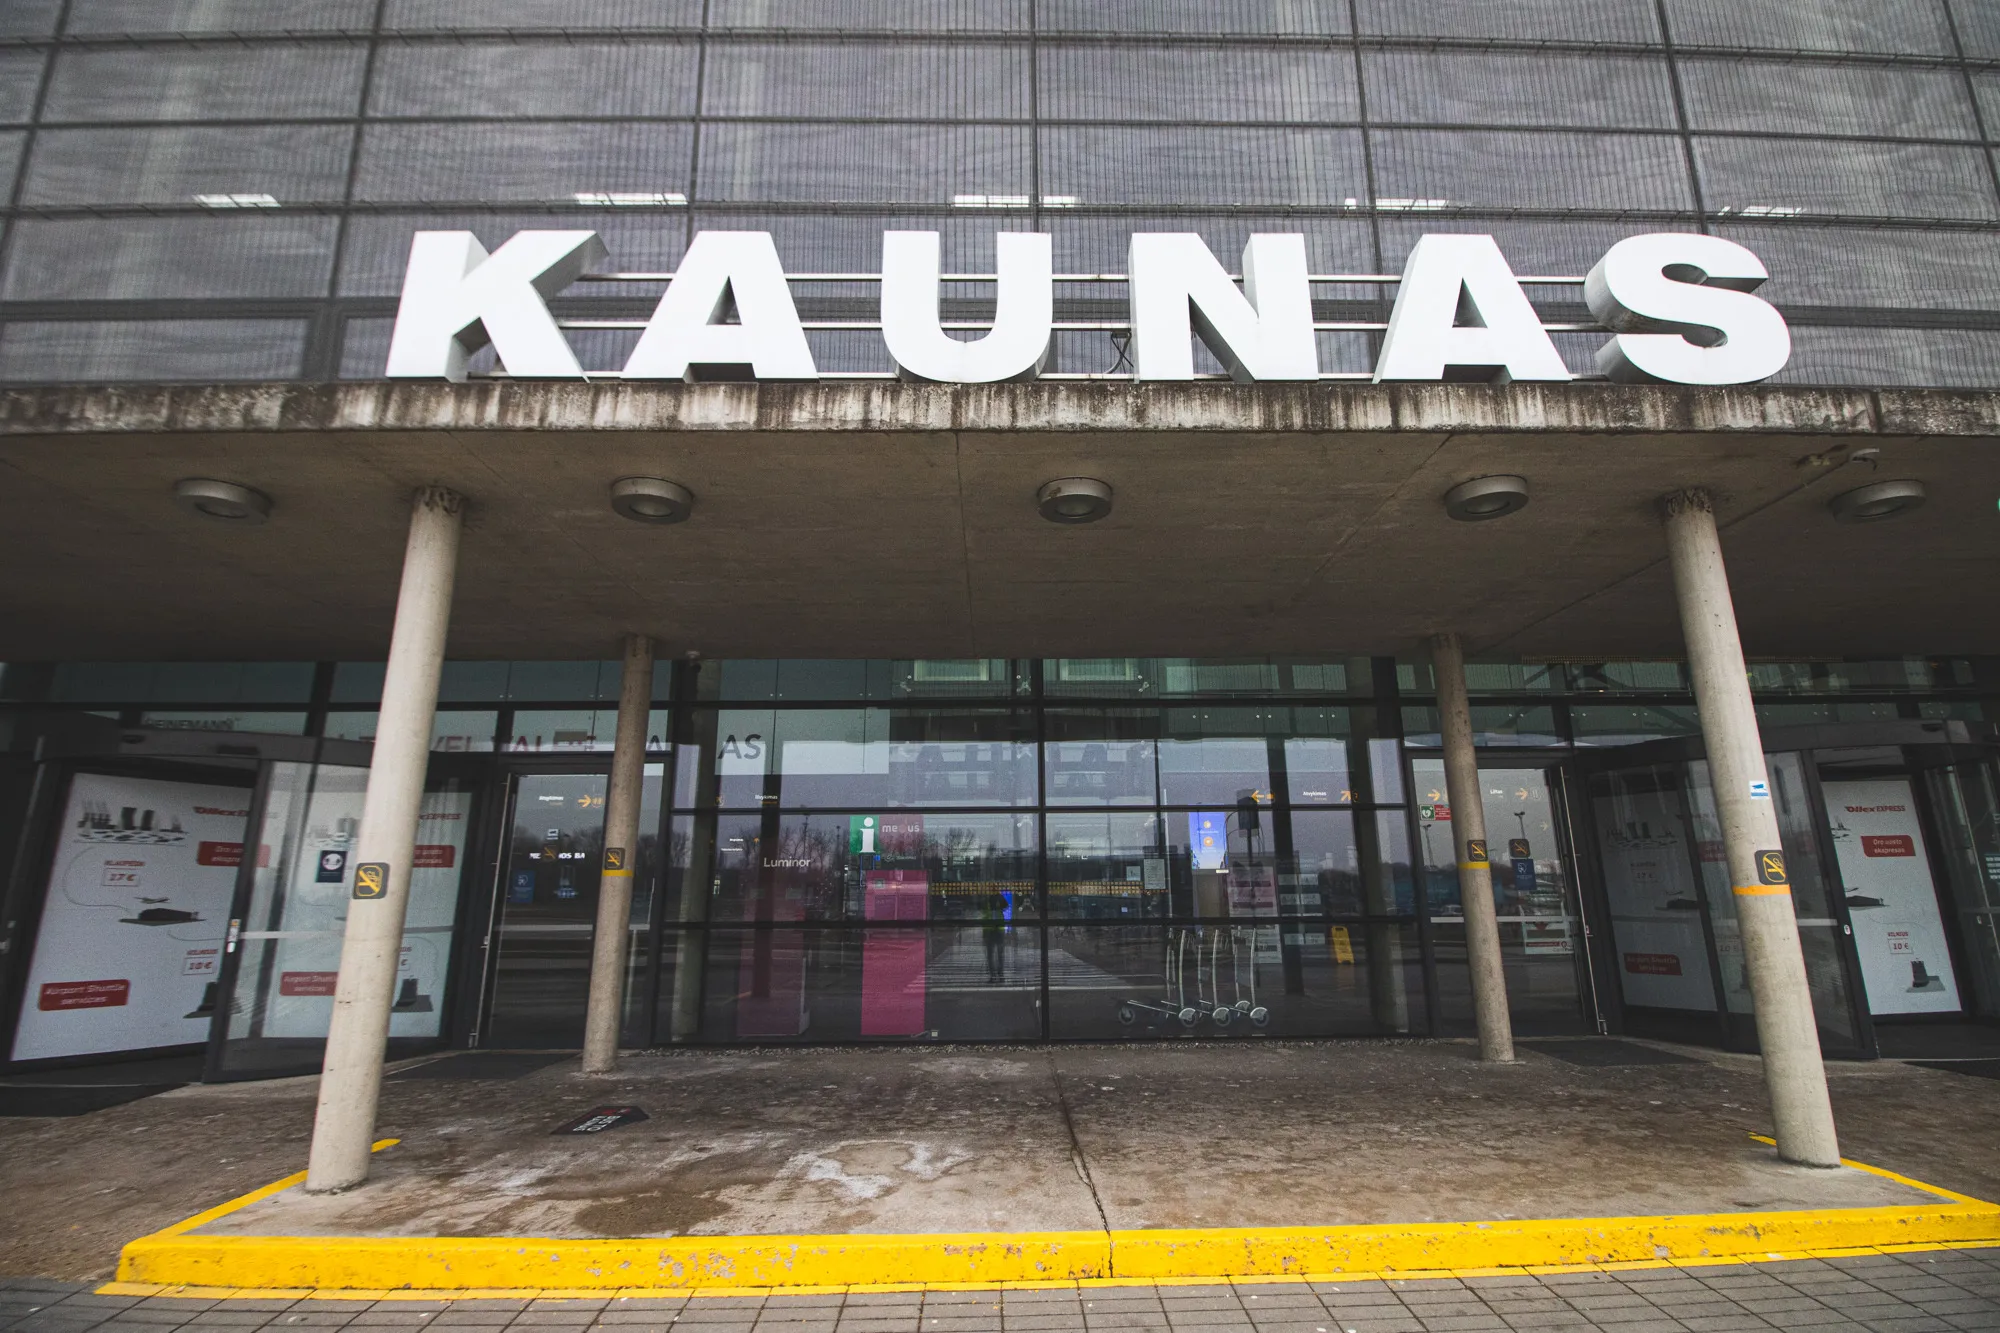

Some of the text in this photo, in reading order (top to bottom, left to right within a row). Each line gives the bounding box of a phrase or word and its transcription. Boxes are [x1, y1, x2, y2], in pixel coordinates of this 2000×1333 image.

[385, 229, 1793, 386] KAUNAS
[763, 857, 811, 868] Luminor
[44, 983, 126, 996] Airport Shuttle
